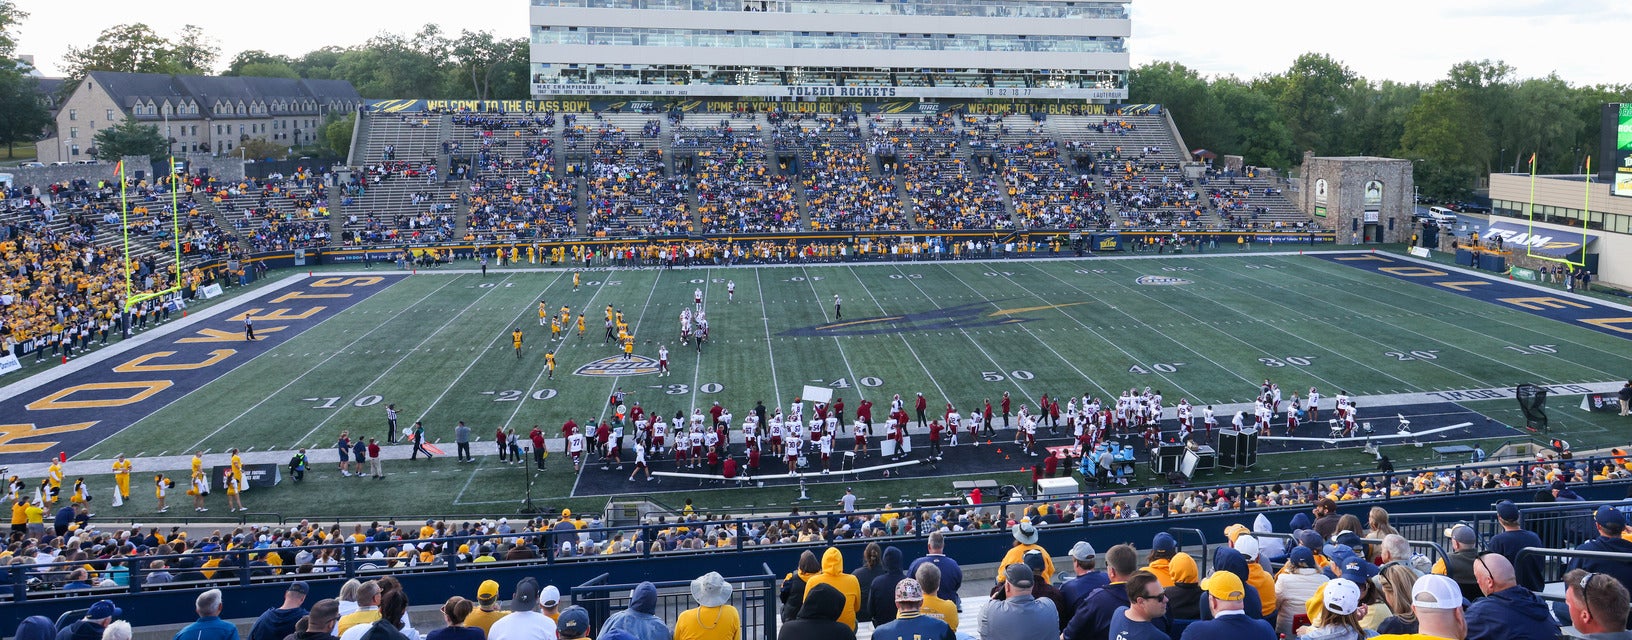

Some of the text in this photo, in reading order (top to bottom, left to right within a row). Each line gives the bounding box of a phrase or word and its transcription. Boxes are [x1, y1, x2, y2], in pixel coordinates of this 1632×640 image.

[788, 87, 896, 96] TOLEDO ROCKETS
[484, 100, 498, 112] TO
[502, 101, 524, 112] THE
[562, 101, 592, 112] BOWL
[1014, 104, 1026, 113] TO
[1482, 228, 1554, 248] TEAM
[1385, 350, 1438, 361] 20
[1505, 344, 1558, 355] 10
[1257, 356, 1312, 368] 30
[1129, 363, 1178, 375] 40
[982, 370, 1035, 382] 50
[829, 376, 884, 389] 40
[493, 388, 559, 402] 20
[666, 383, 725, 395] 30
[312, 395, 384, 410] 10
